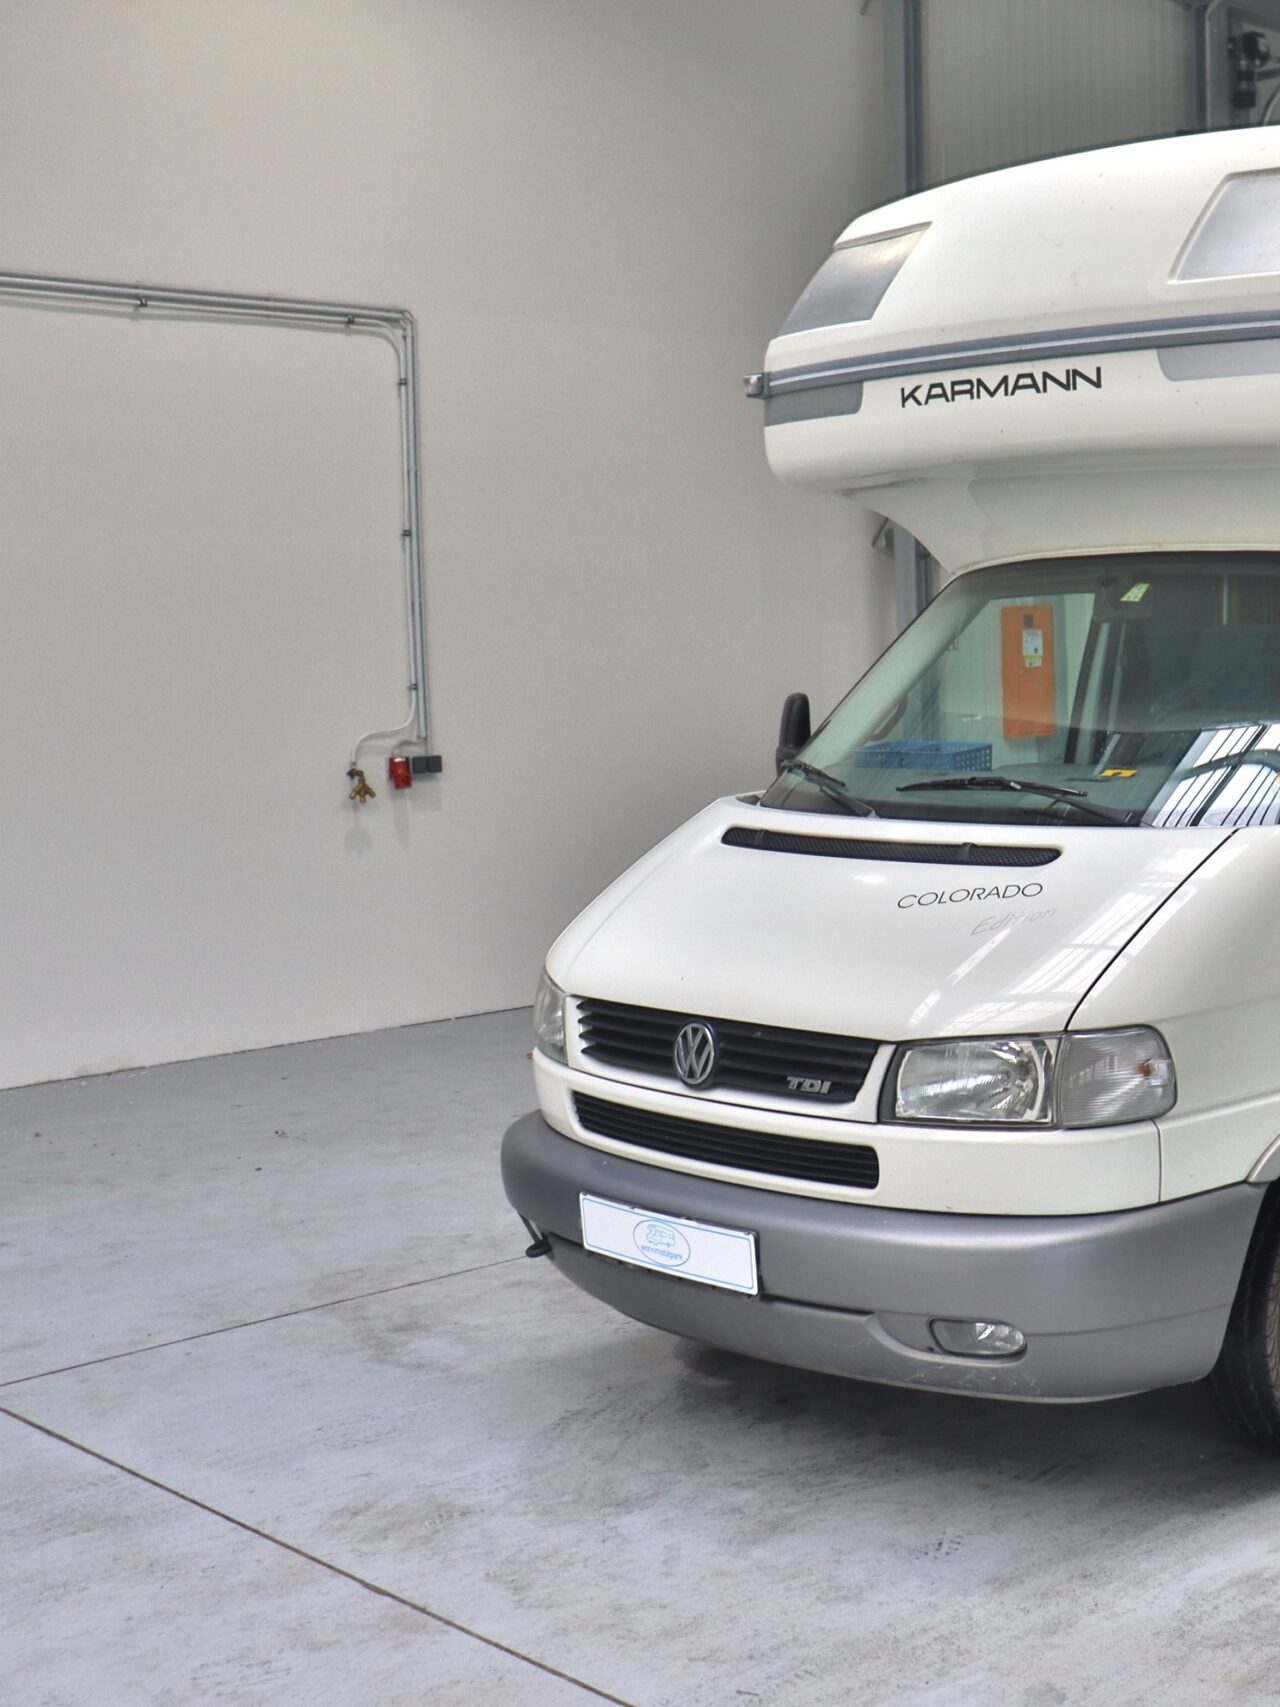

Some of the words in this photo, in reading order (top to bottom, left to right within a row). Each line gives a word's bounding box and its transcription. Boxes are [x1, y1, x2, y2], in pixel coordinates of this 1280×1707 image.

[900, 366, 1102, 408] KARMANN
[897, 883, 1043, 908] COLORADO
[970, 907, 1057, 936] Edition
[787, 1076, 832, 1095] TDI
